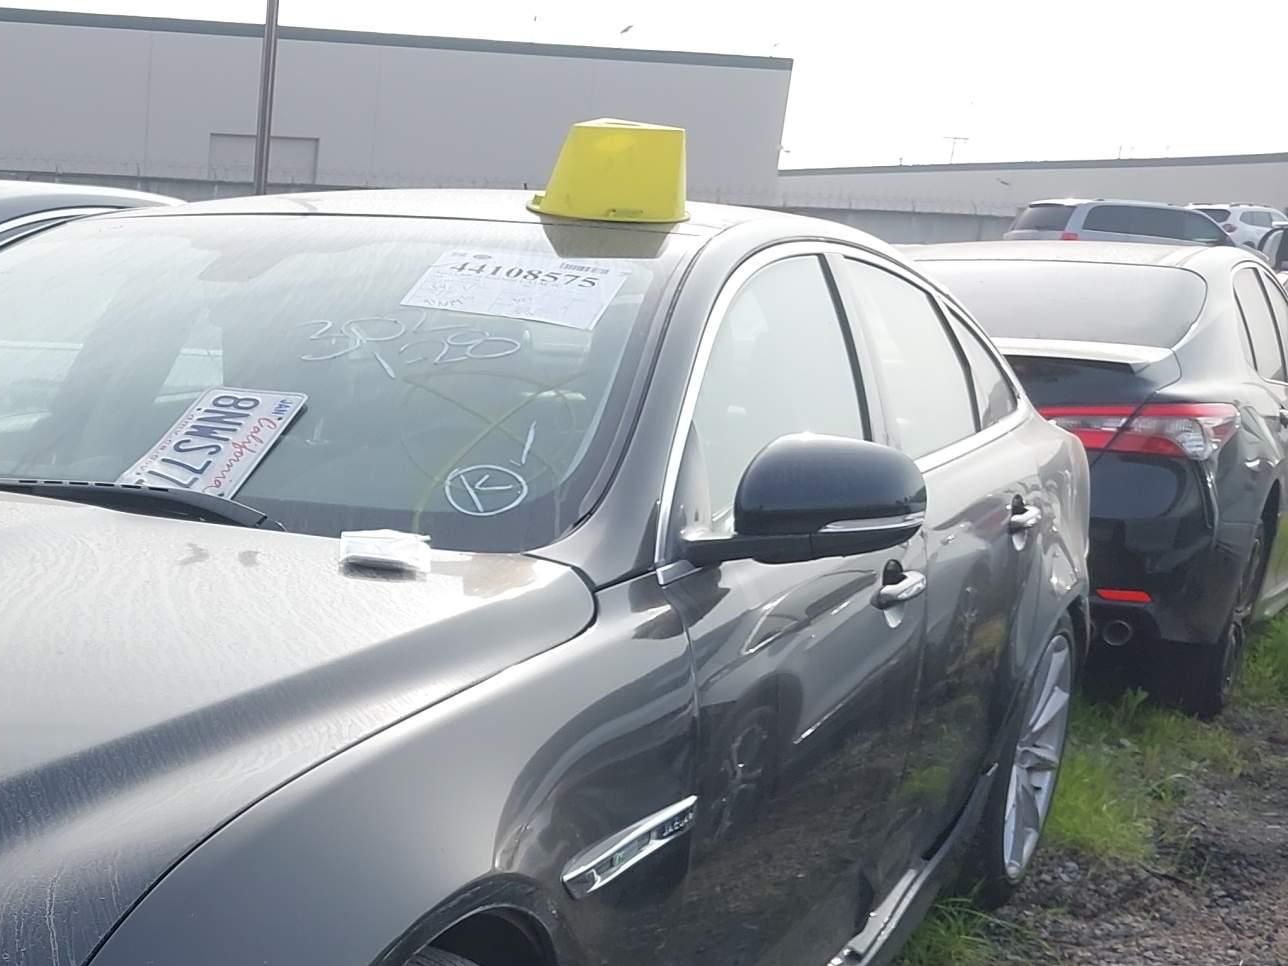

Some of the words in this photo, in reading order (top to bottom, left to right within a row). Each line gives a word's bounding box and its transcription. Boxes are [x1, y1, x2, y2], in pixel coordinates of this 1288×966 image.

[449, 261, 601, 289] 44108575
[272, 397, 294, 416] JAN
[135, 394, 261, 489] 8NWS77
[202, 416, 278, 492] California
